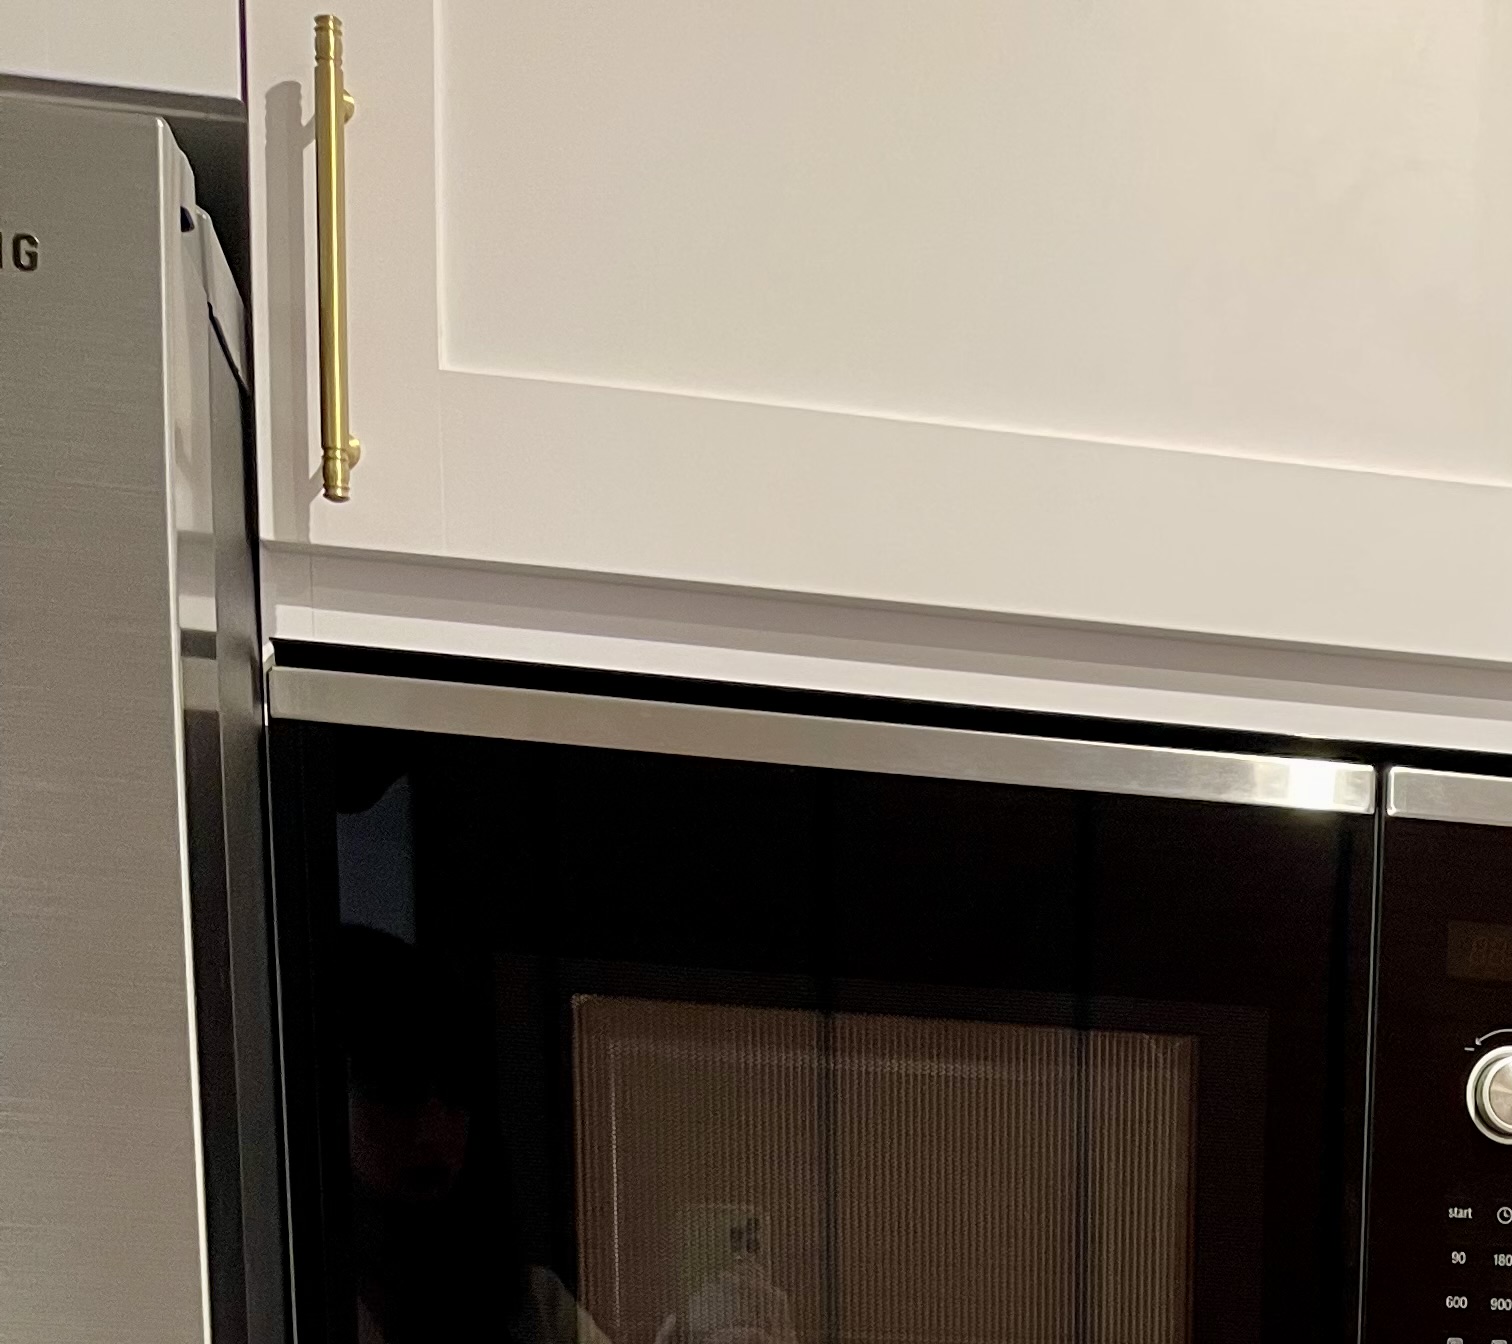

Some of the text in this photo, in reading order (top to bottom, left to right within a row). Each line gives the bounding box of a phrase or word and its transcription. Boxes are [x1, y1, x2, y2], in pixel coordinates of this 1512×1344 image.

[0, 232, 40, 273] G
[1448, 1207, 1473, 1219] start
[1451, 1251, 1467, 1266] 90
[1445, 1294, 1468, 1310] 600
[1489, 1296, 1512, 1312] 900
